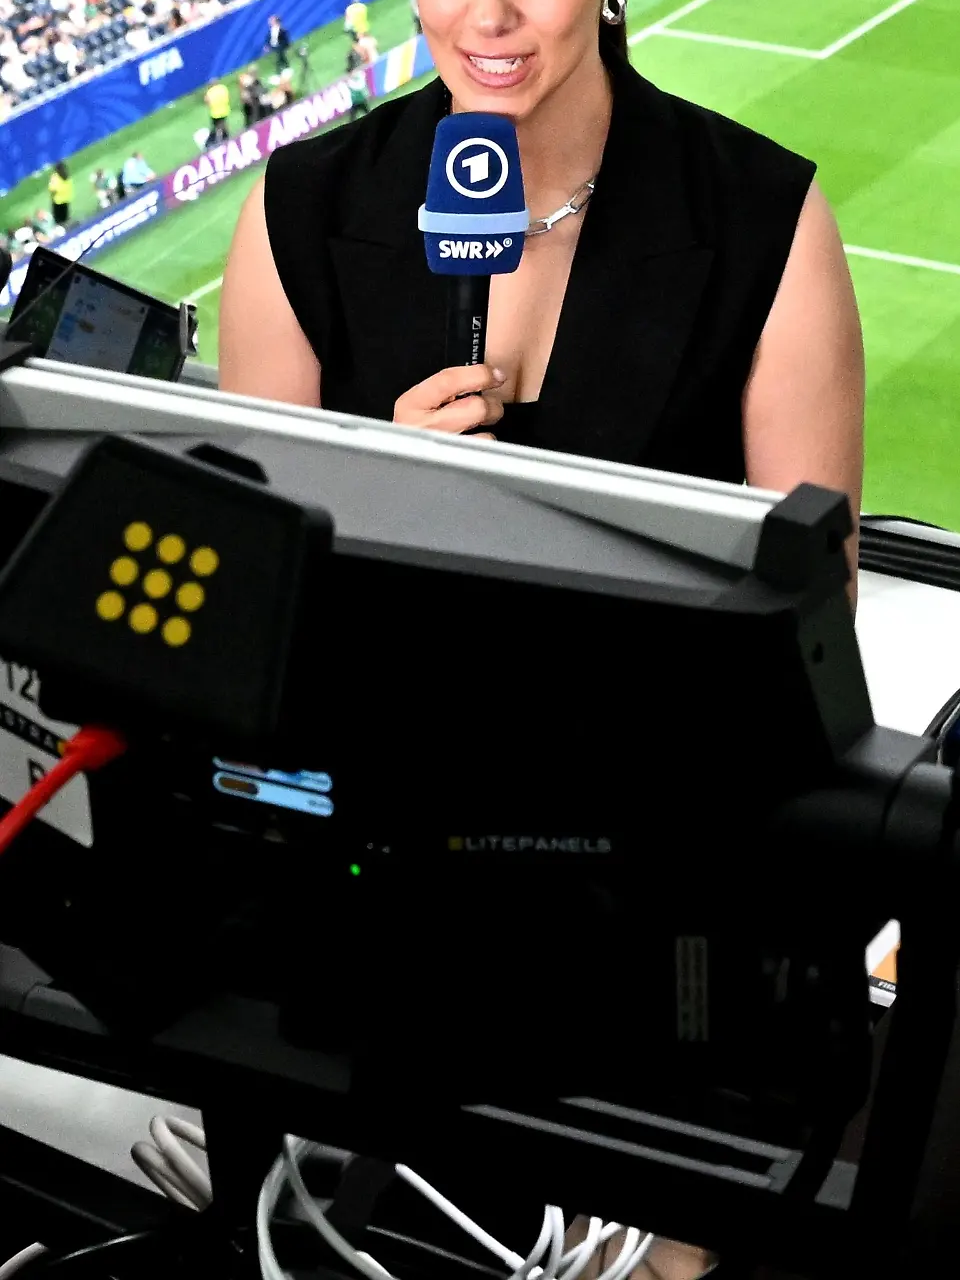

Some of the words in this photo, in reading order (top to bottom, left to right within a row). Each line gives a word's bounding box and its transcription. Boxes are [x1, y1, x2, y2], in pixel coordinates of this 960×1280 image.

[138, 47, 184, 86] FIFA
[173, 130, 262, 201] QATAR
[267, 77, 354, 151] AIRWAY
[439, 239, 484, 259] SWR
[465, 835, 612, 853] LITEPANELS
